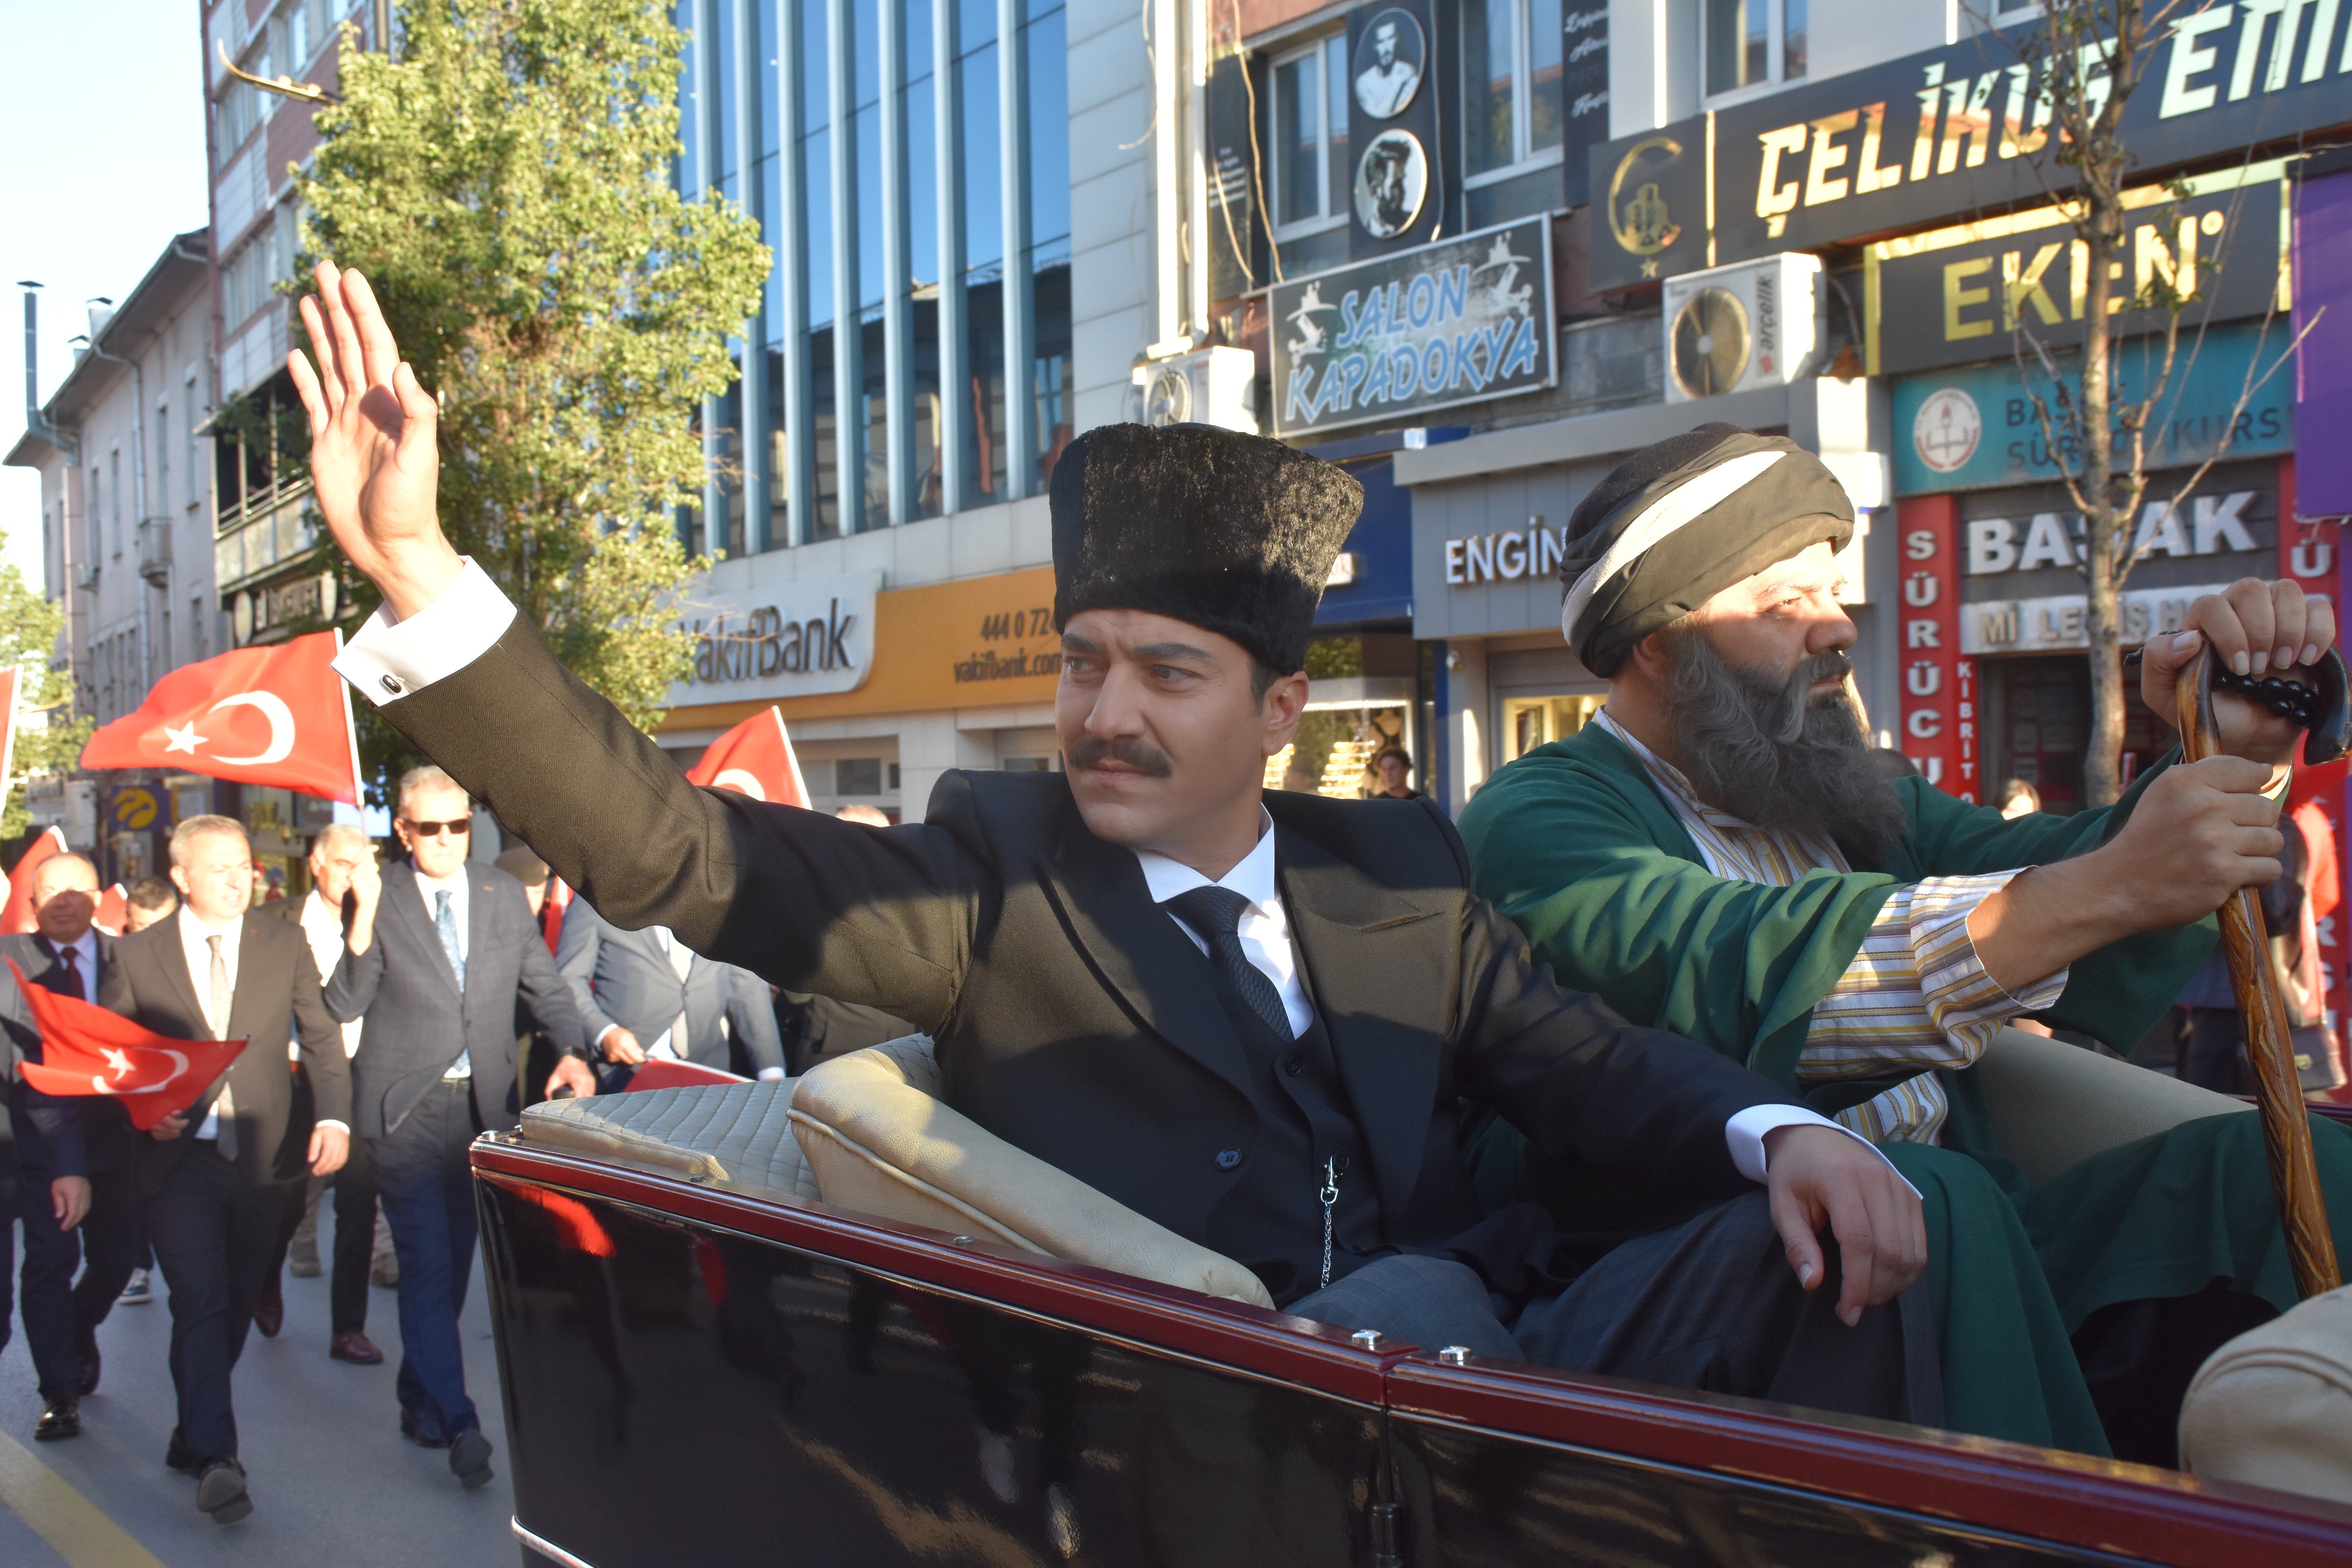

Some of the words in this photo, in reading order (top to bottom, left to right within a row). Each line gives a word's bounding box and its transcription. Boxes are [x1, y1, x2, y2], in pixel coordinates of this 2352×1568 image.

[1336, 265, 1470, 349] SALON
[1285, 316, 1539, 425] KAPADOKYA
[1968, 491, 2258, 575] BAAK
[981, 612, 1010, 641] 444
[1014, 611, 1025, 639] 0
